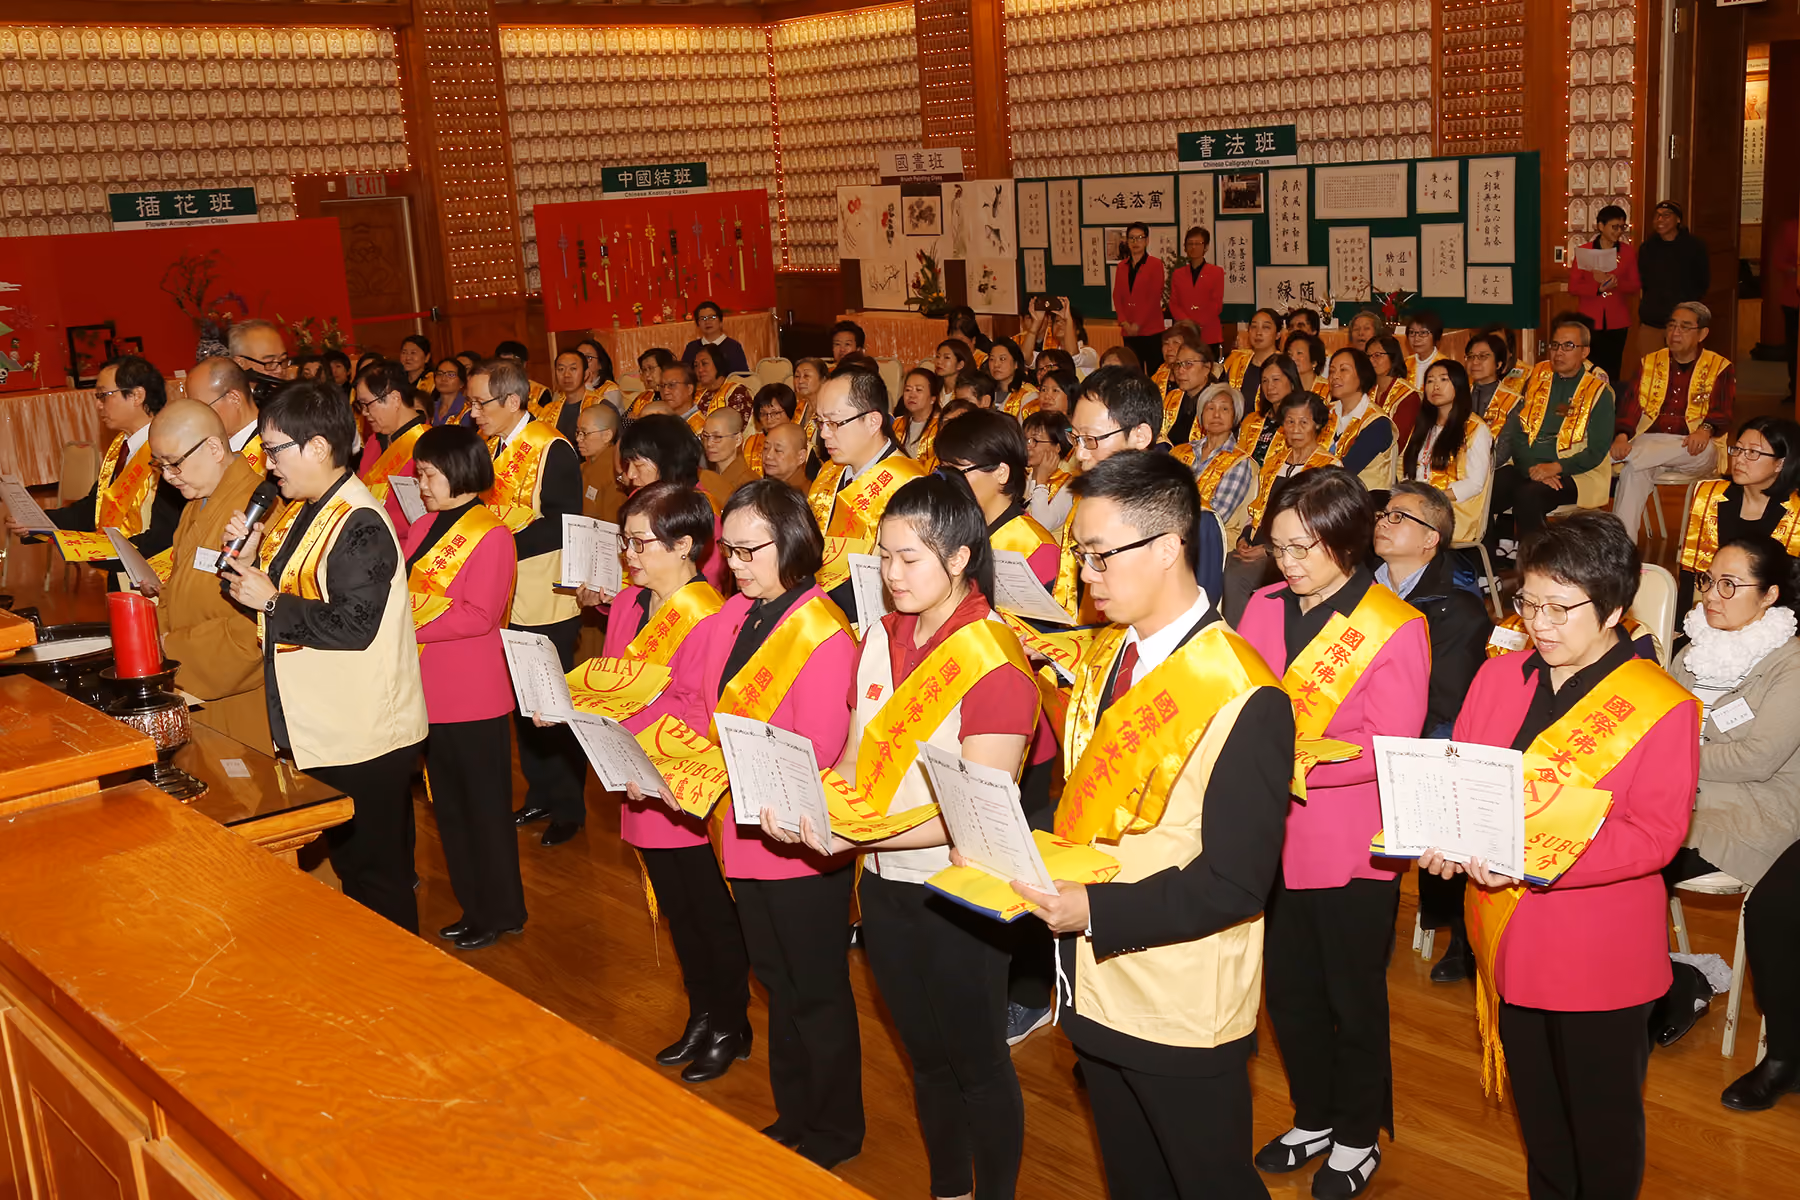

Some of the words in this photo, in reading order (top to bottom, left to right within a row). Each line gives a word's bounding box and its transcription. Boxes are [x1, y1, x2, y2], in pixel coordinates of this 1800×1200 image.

[1195, 131, 1277, 158] 書法班
[894, 152, 945, 172] 國畫班
[1225, 159, 1255, 168] Calligraphy
[355, 176, 382, 195] EXIT
[617, 167, 693, 189] 中國結班
[135, 193, 235, 218] 插花班
[145, 220, 167, 228] Flower
[169, 219, 210, 227] Arrangement
[210, 217, 228, 225] Class
[591, 657, 633, 676] BLIA
[665, 721, 716, 754] BLI
[672, 759, 730, 787] SUBCH
[828, 779, 880, 820] BLI
[1528, 831, 1585, 858] SUBC
